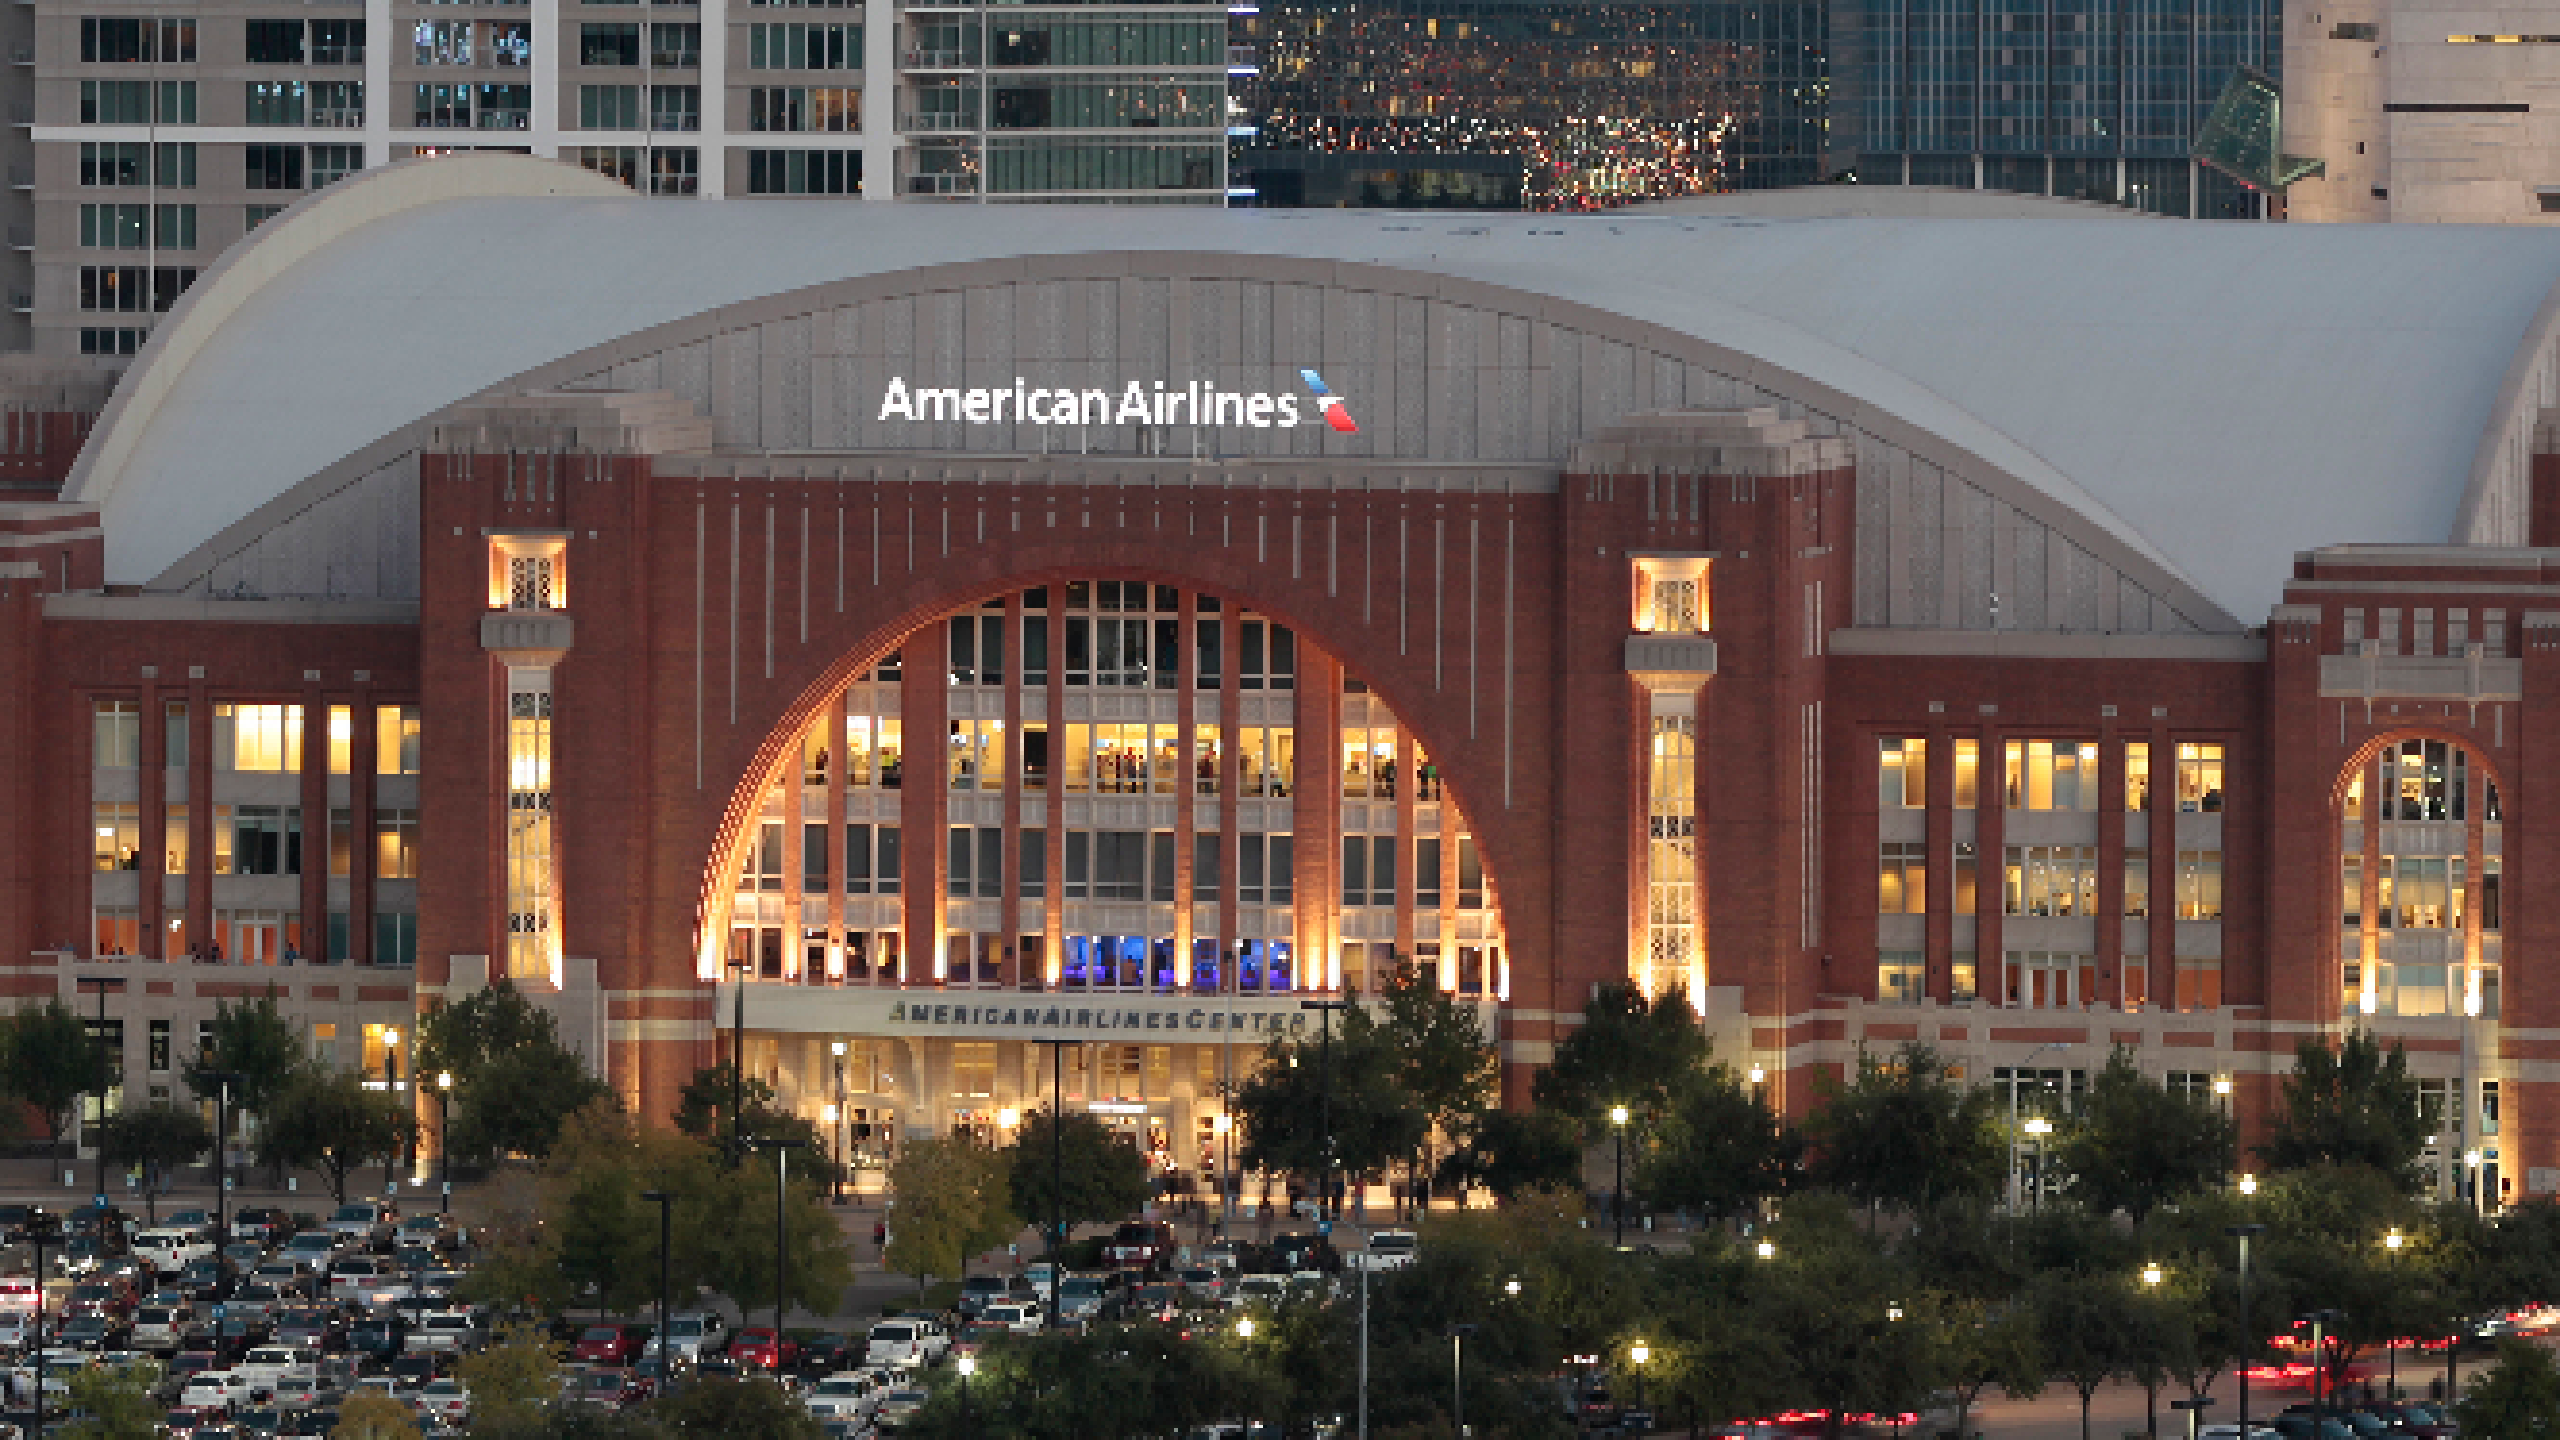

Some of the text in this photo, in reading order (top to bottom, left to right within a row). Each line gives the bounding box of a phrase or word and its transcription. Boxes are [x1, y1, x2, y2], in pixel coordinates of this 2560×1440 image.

[878, 376, 1300, 428] American Airlines
[888, 1001, 1306, 1033] AMERICAN AIRLINES CENTER
